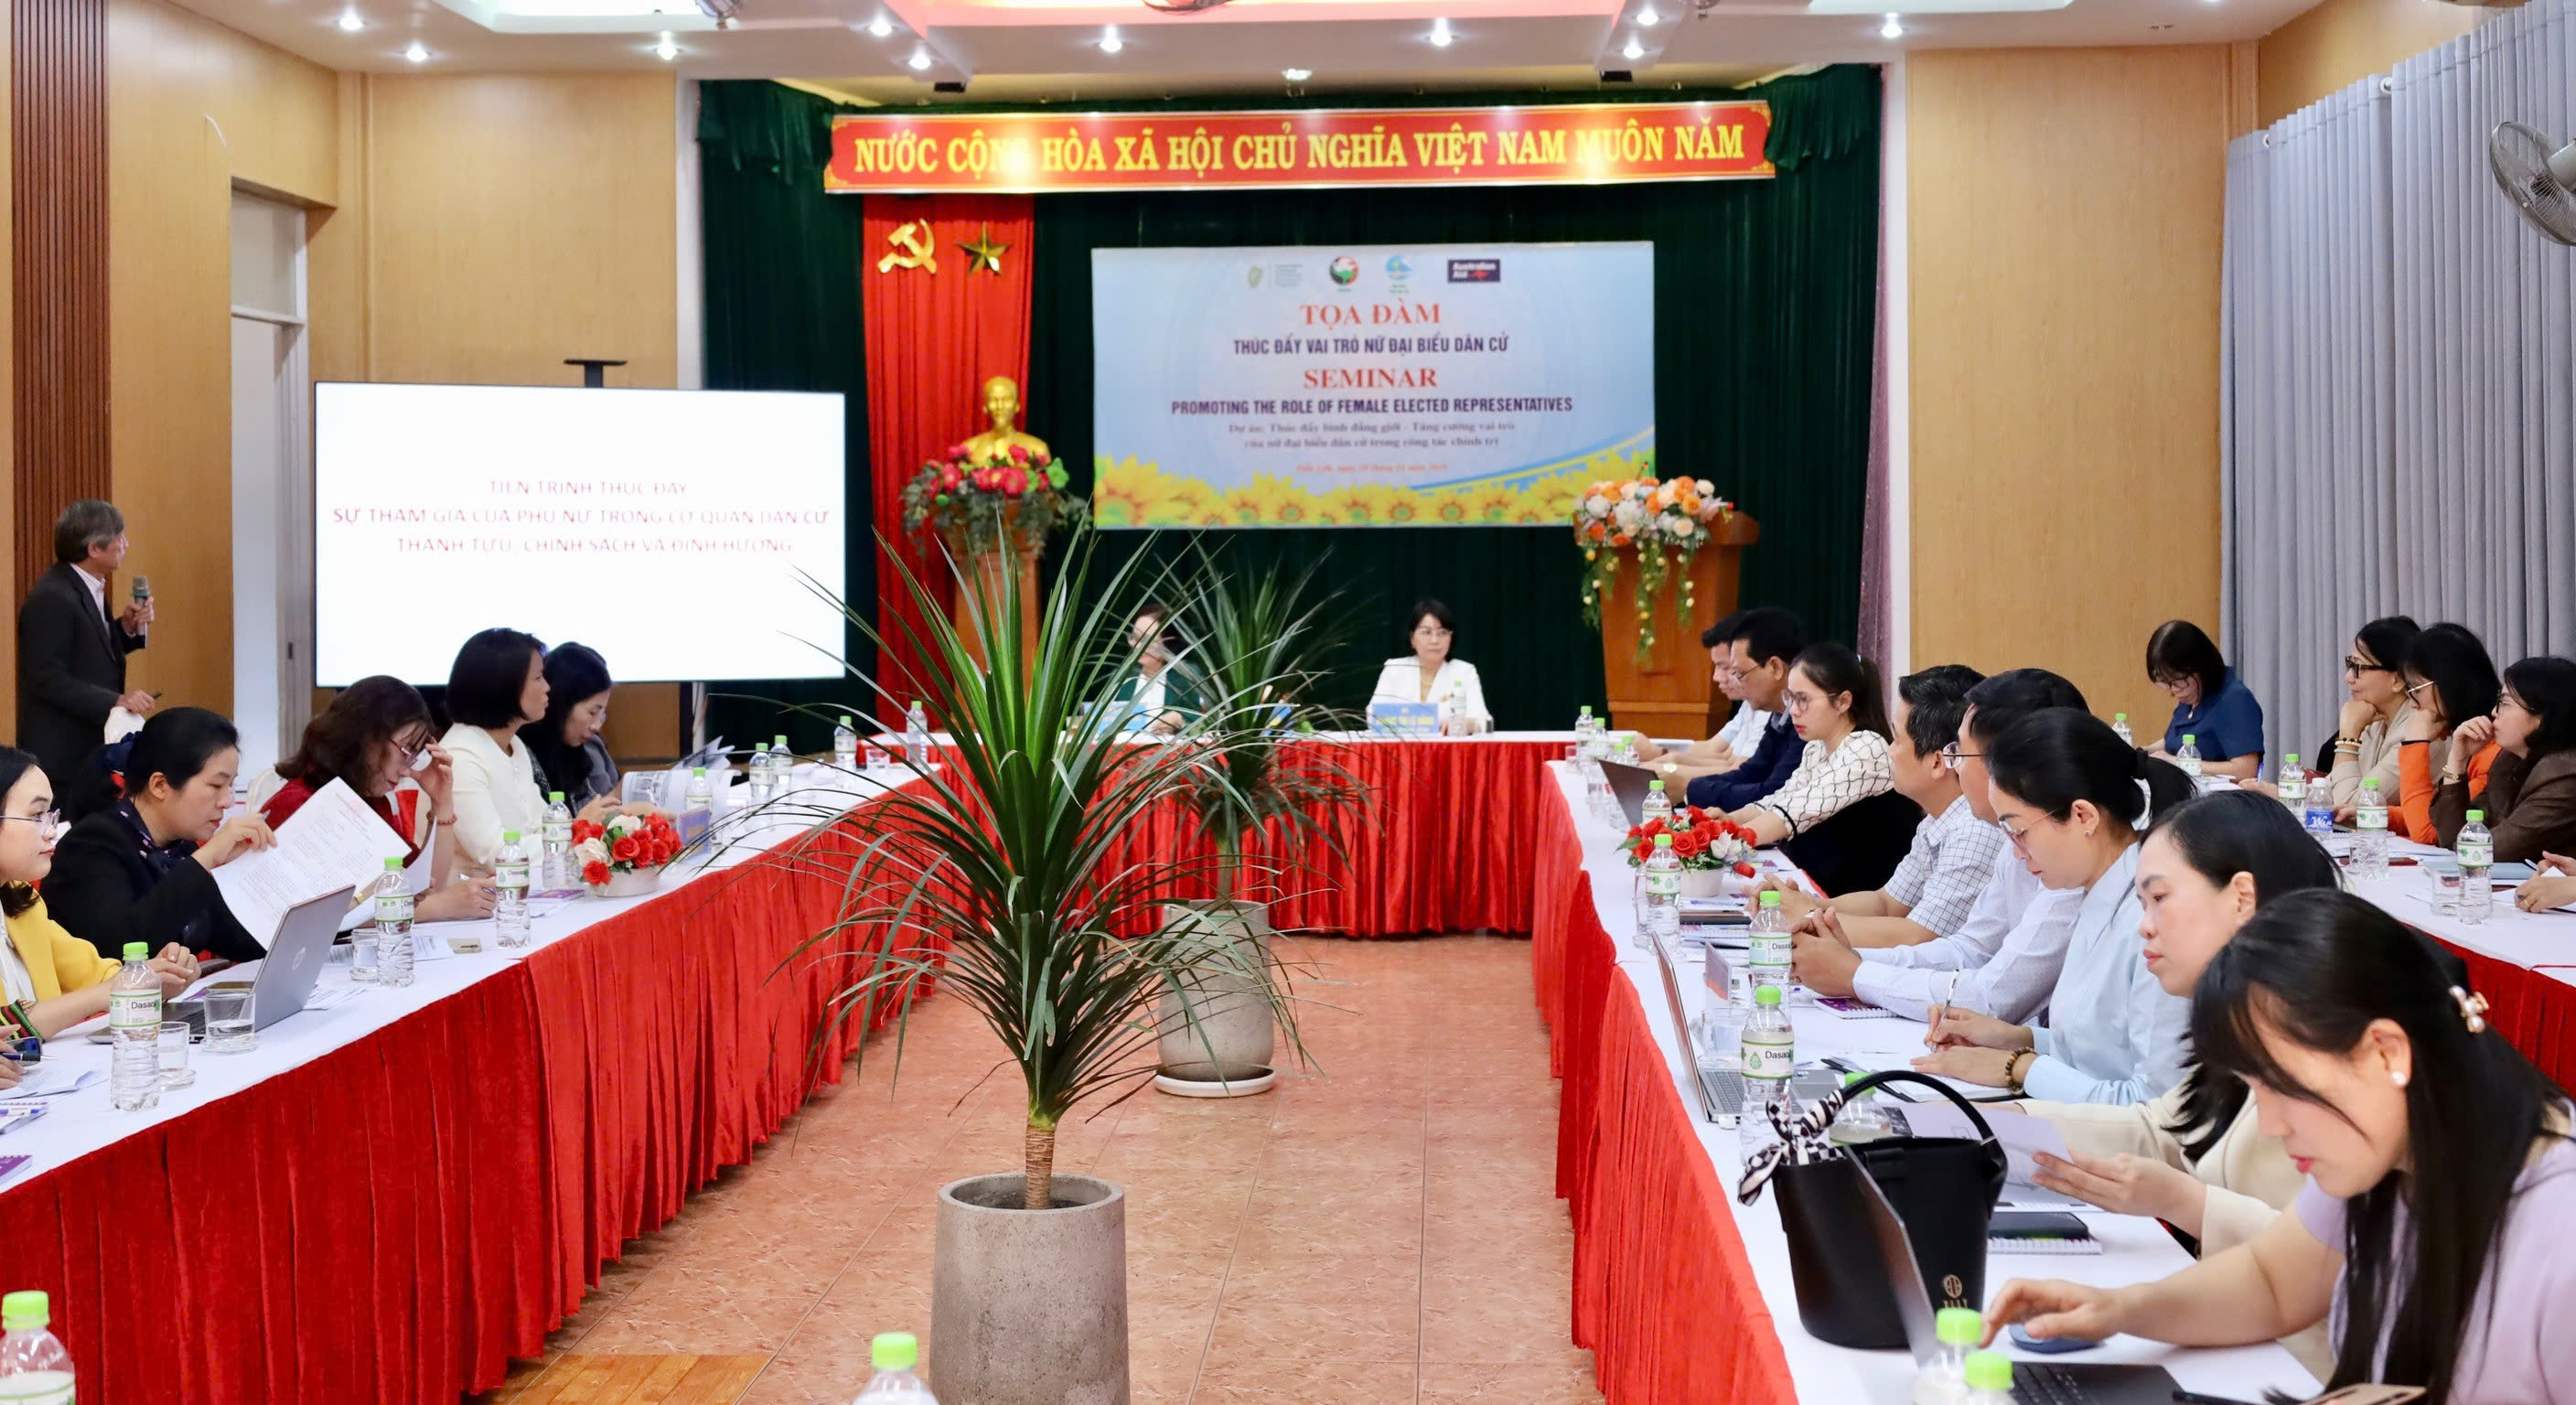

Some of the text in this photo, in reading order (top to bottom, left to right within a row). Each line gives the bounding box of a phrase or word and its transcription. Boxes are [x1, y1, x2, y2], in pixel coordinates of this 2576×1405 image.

[854, 129, 938, 174] NƯỚC
[1041, 127, 1108, 171] HÒA
[1115, 127, 1160, 171] XÃ
[1167, 125, 1224, 177] HỘI
[1233, 121, 1298, 170] CHỦ
[1307, 123, 1409, 168] NGHĨA
[1415, 122, 1487, 175] VIỆT
[1497, 130, 1567, 166] NAM
[1575, 118, 1664, 163] MUÔN
[1674, 117, 1744, 160] NĂM
[1300, 298, 1442, 329] TỌA ĐÀM
[1304, 368, 1438, 390] SEMINAR
[1172, 397, 1572, 415] PROMOTING THE ROLE OF FEMALE ELECTED REPRESENTATIVES
